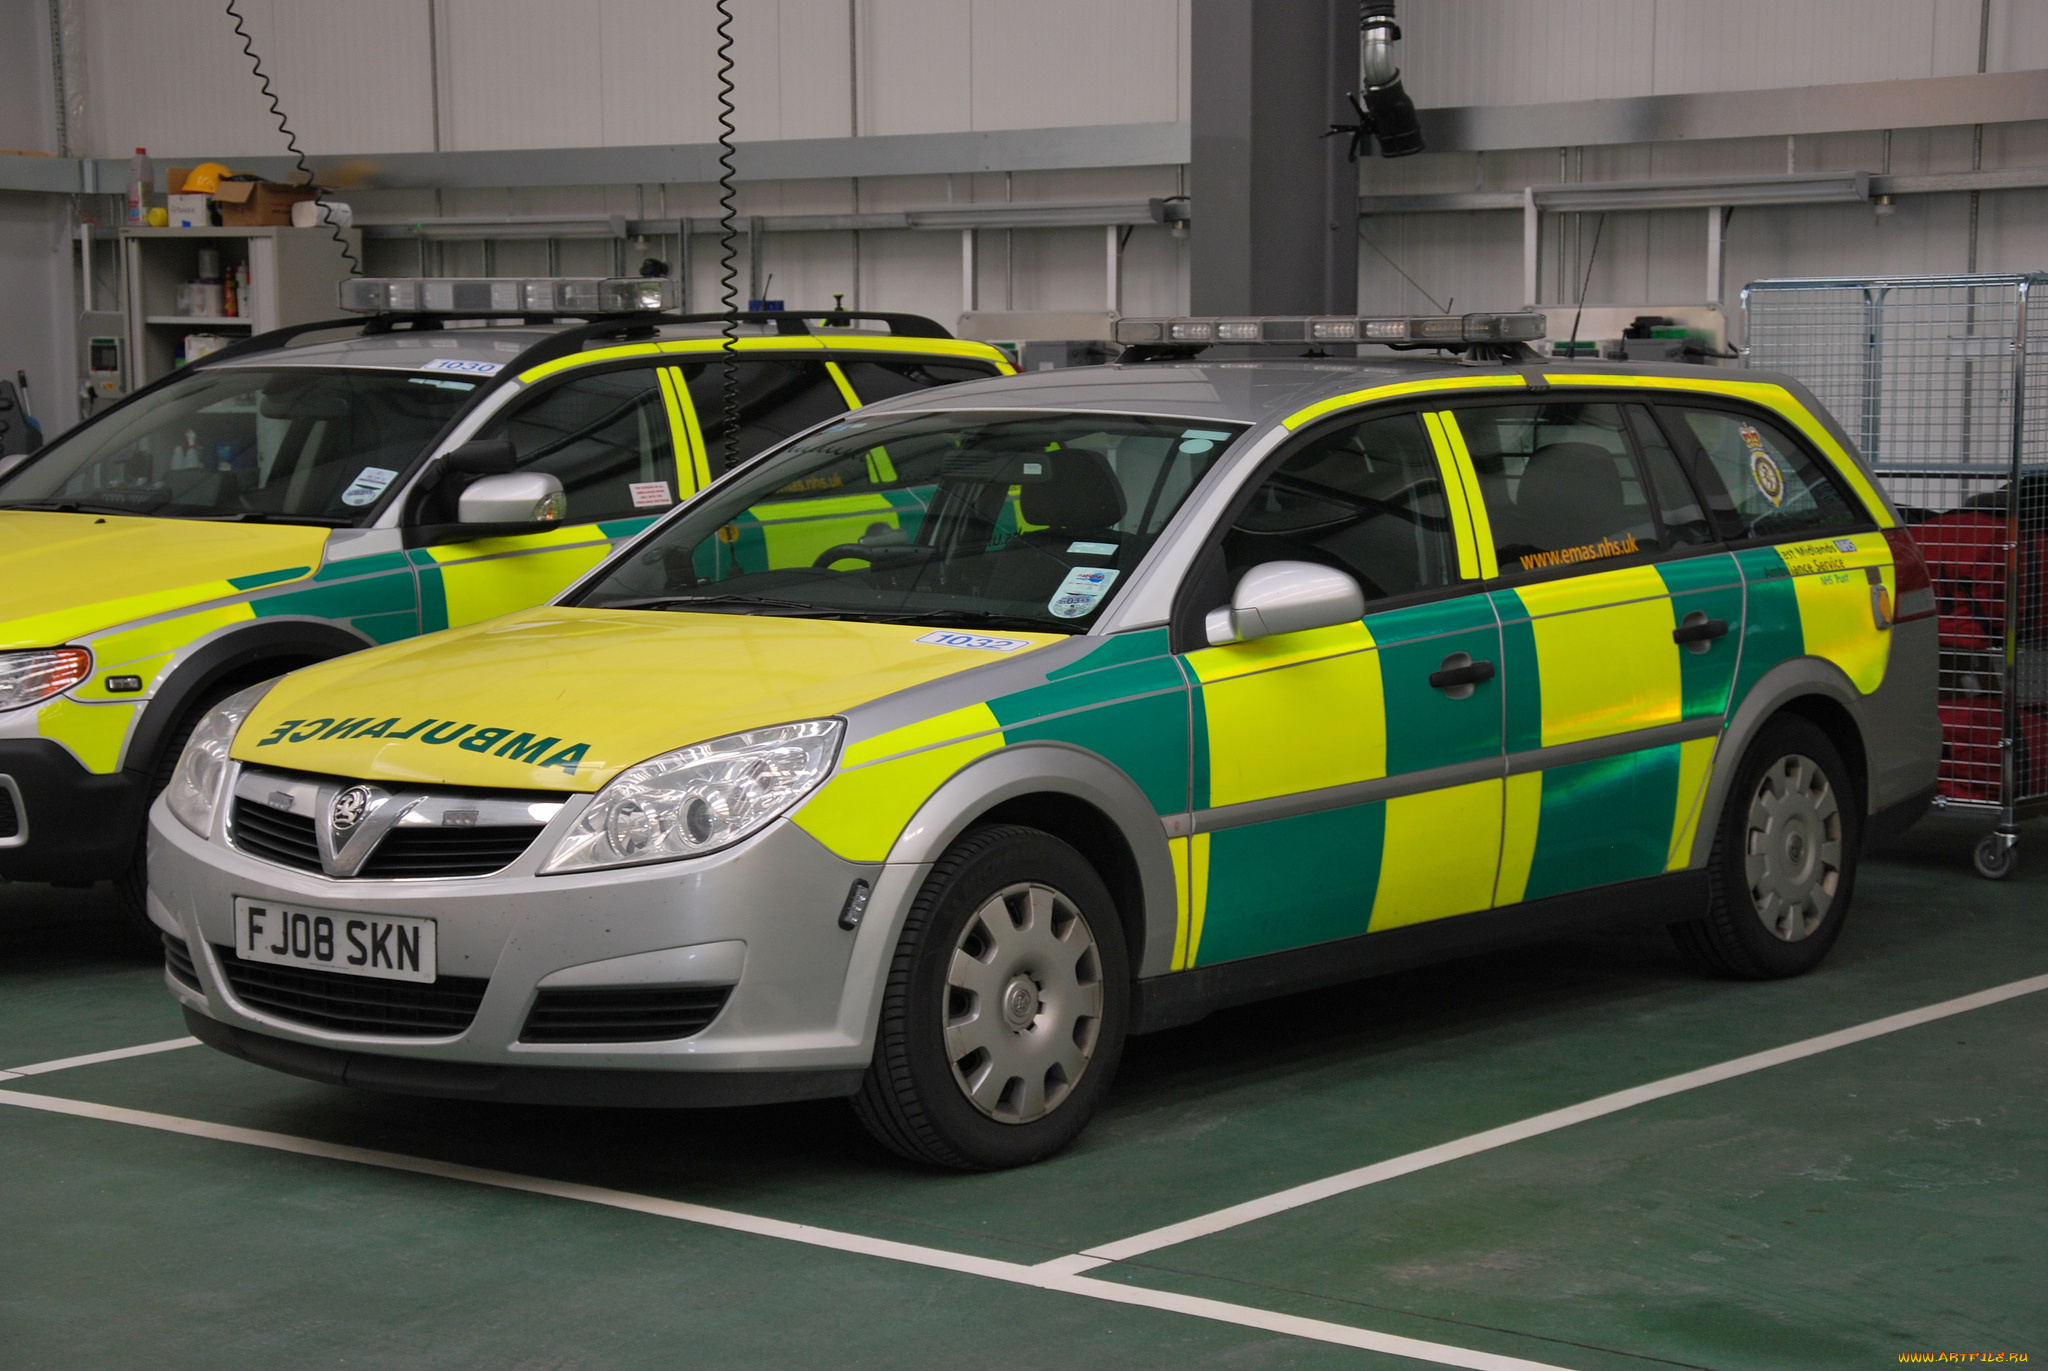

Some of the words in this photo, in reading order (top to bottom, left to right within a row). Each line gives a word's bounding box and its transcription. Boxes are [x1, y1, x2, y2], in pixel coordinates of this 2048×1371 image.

[438, 360, 496, 372] 1030
[1519, 532, 1640, 571] www.emas.nhs.uk
[1795, 542, 1838, 557] Midlands
[1812, 557, 1846, 573] Service
[934, 634, 1014, 650] 1032
[248, 906, 335, 962] FJ08
[345, 919, 421, 973] SKN
